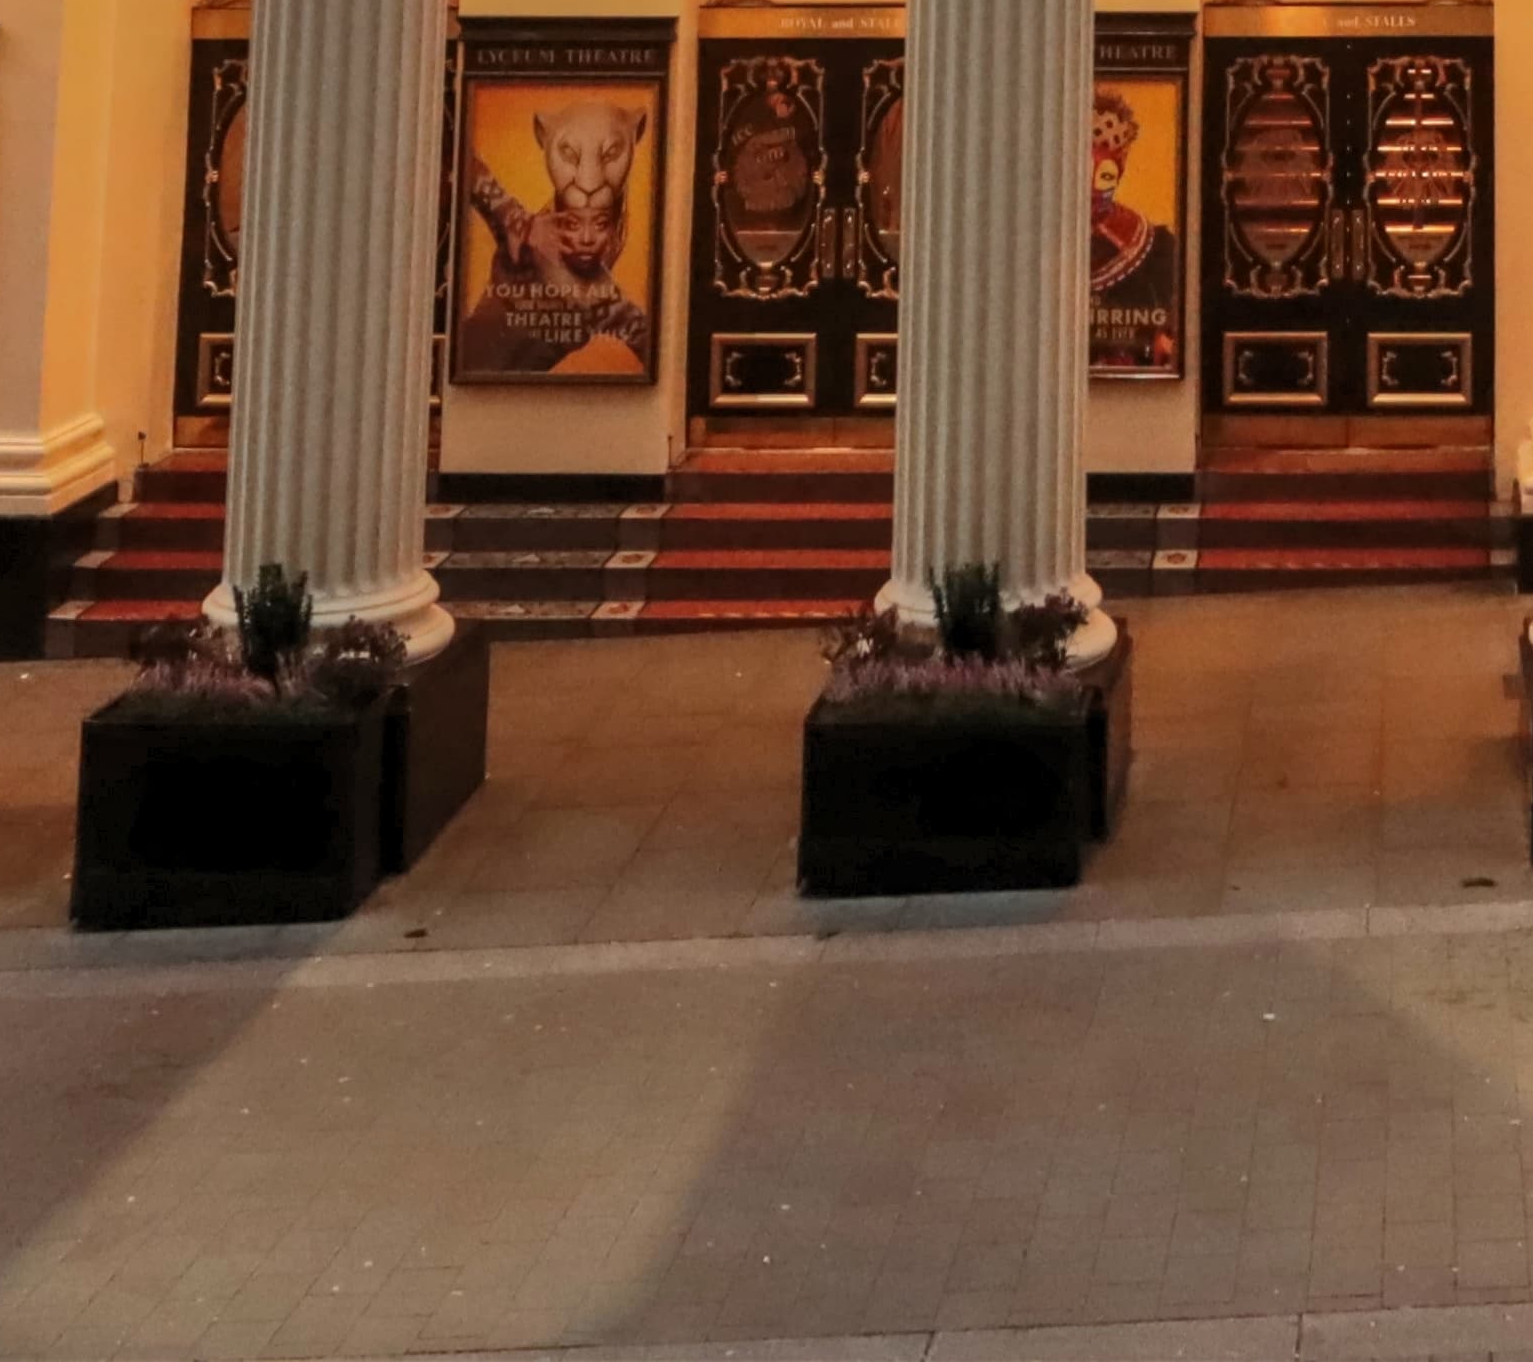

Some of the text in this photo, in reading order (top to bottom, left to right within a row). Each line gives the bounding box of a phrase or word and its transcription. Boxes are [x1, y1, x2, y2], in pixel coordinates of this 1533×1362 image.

[832, 17, 854, 28] and
[860, 17, 902, 28] STALL
[1365, 15, 1416, 27] STALLS
[477, 49, 653, 64] LYCEUM THEATRE
[1099, 43, 1177, 60] HEATRE
[486, 282, 619, 298] YOU HOPE ALL
[506, 312, 582, 327] THEATRE
[1089, 308, 1167, 325] IRRING
[544, 328, 582, 343] LIKE
